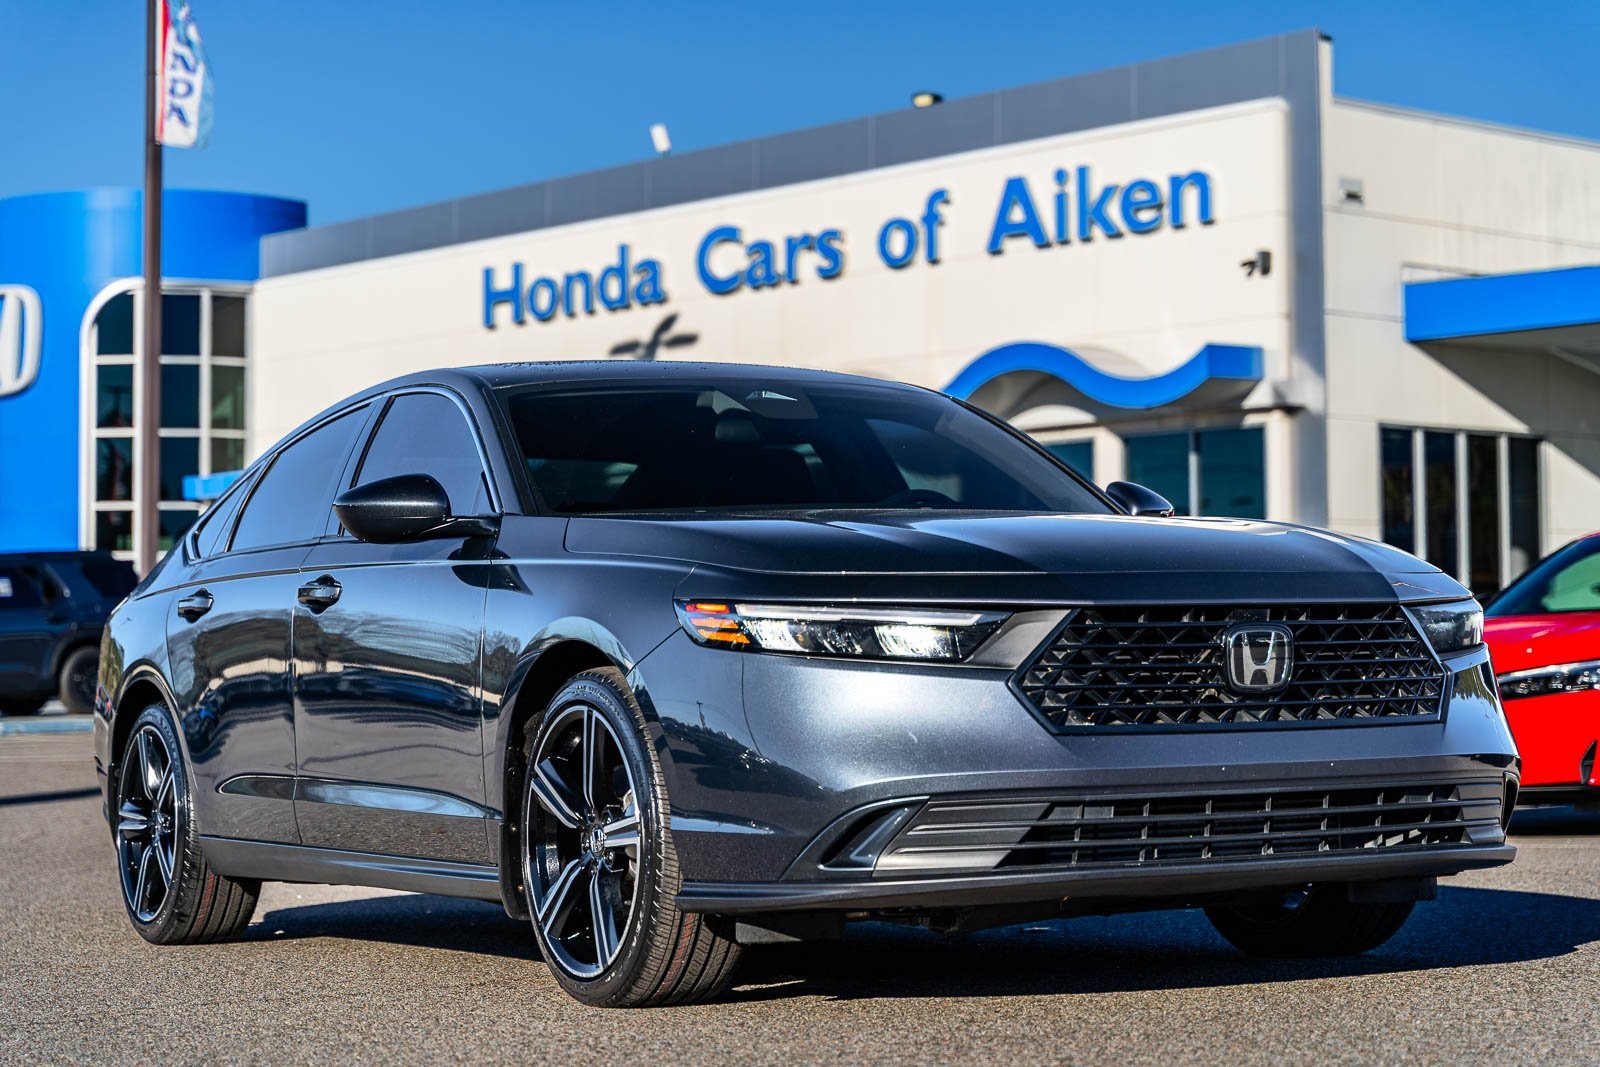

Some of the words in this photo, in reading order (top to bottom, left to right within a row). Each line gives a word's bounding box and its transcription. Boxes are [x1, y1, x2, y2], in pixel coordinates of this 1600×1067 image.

[482, 244, 666, 328] Honda
[695, 224, 843, 295] Cars
[877, 188, 948, 268] of
[986, 164, 1213, 254] Aiken
